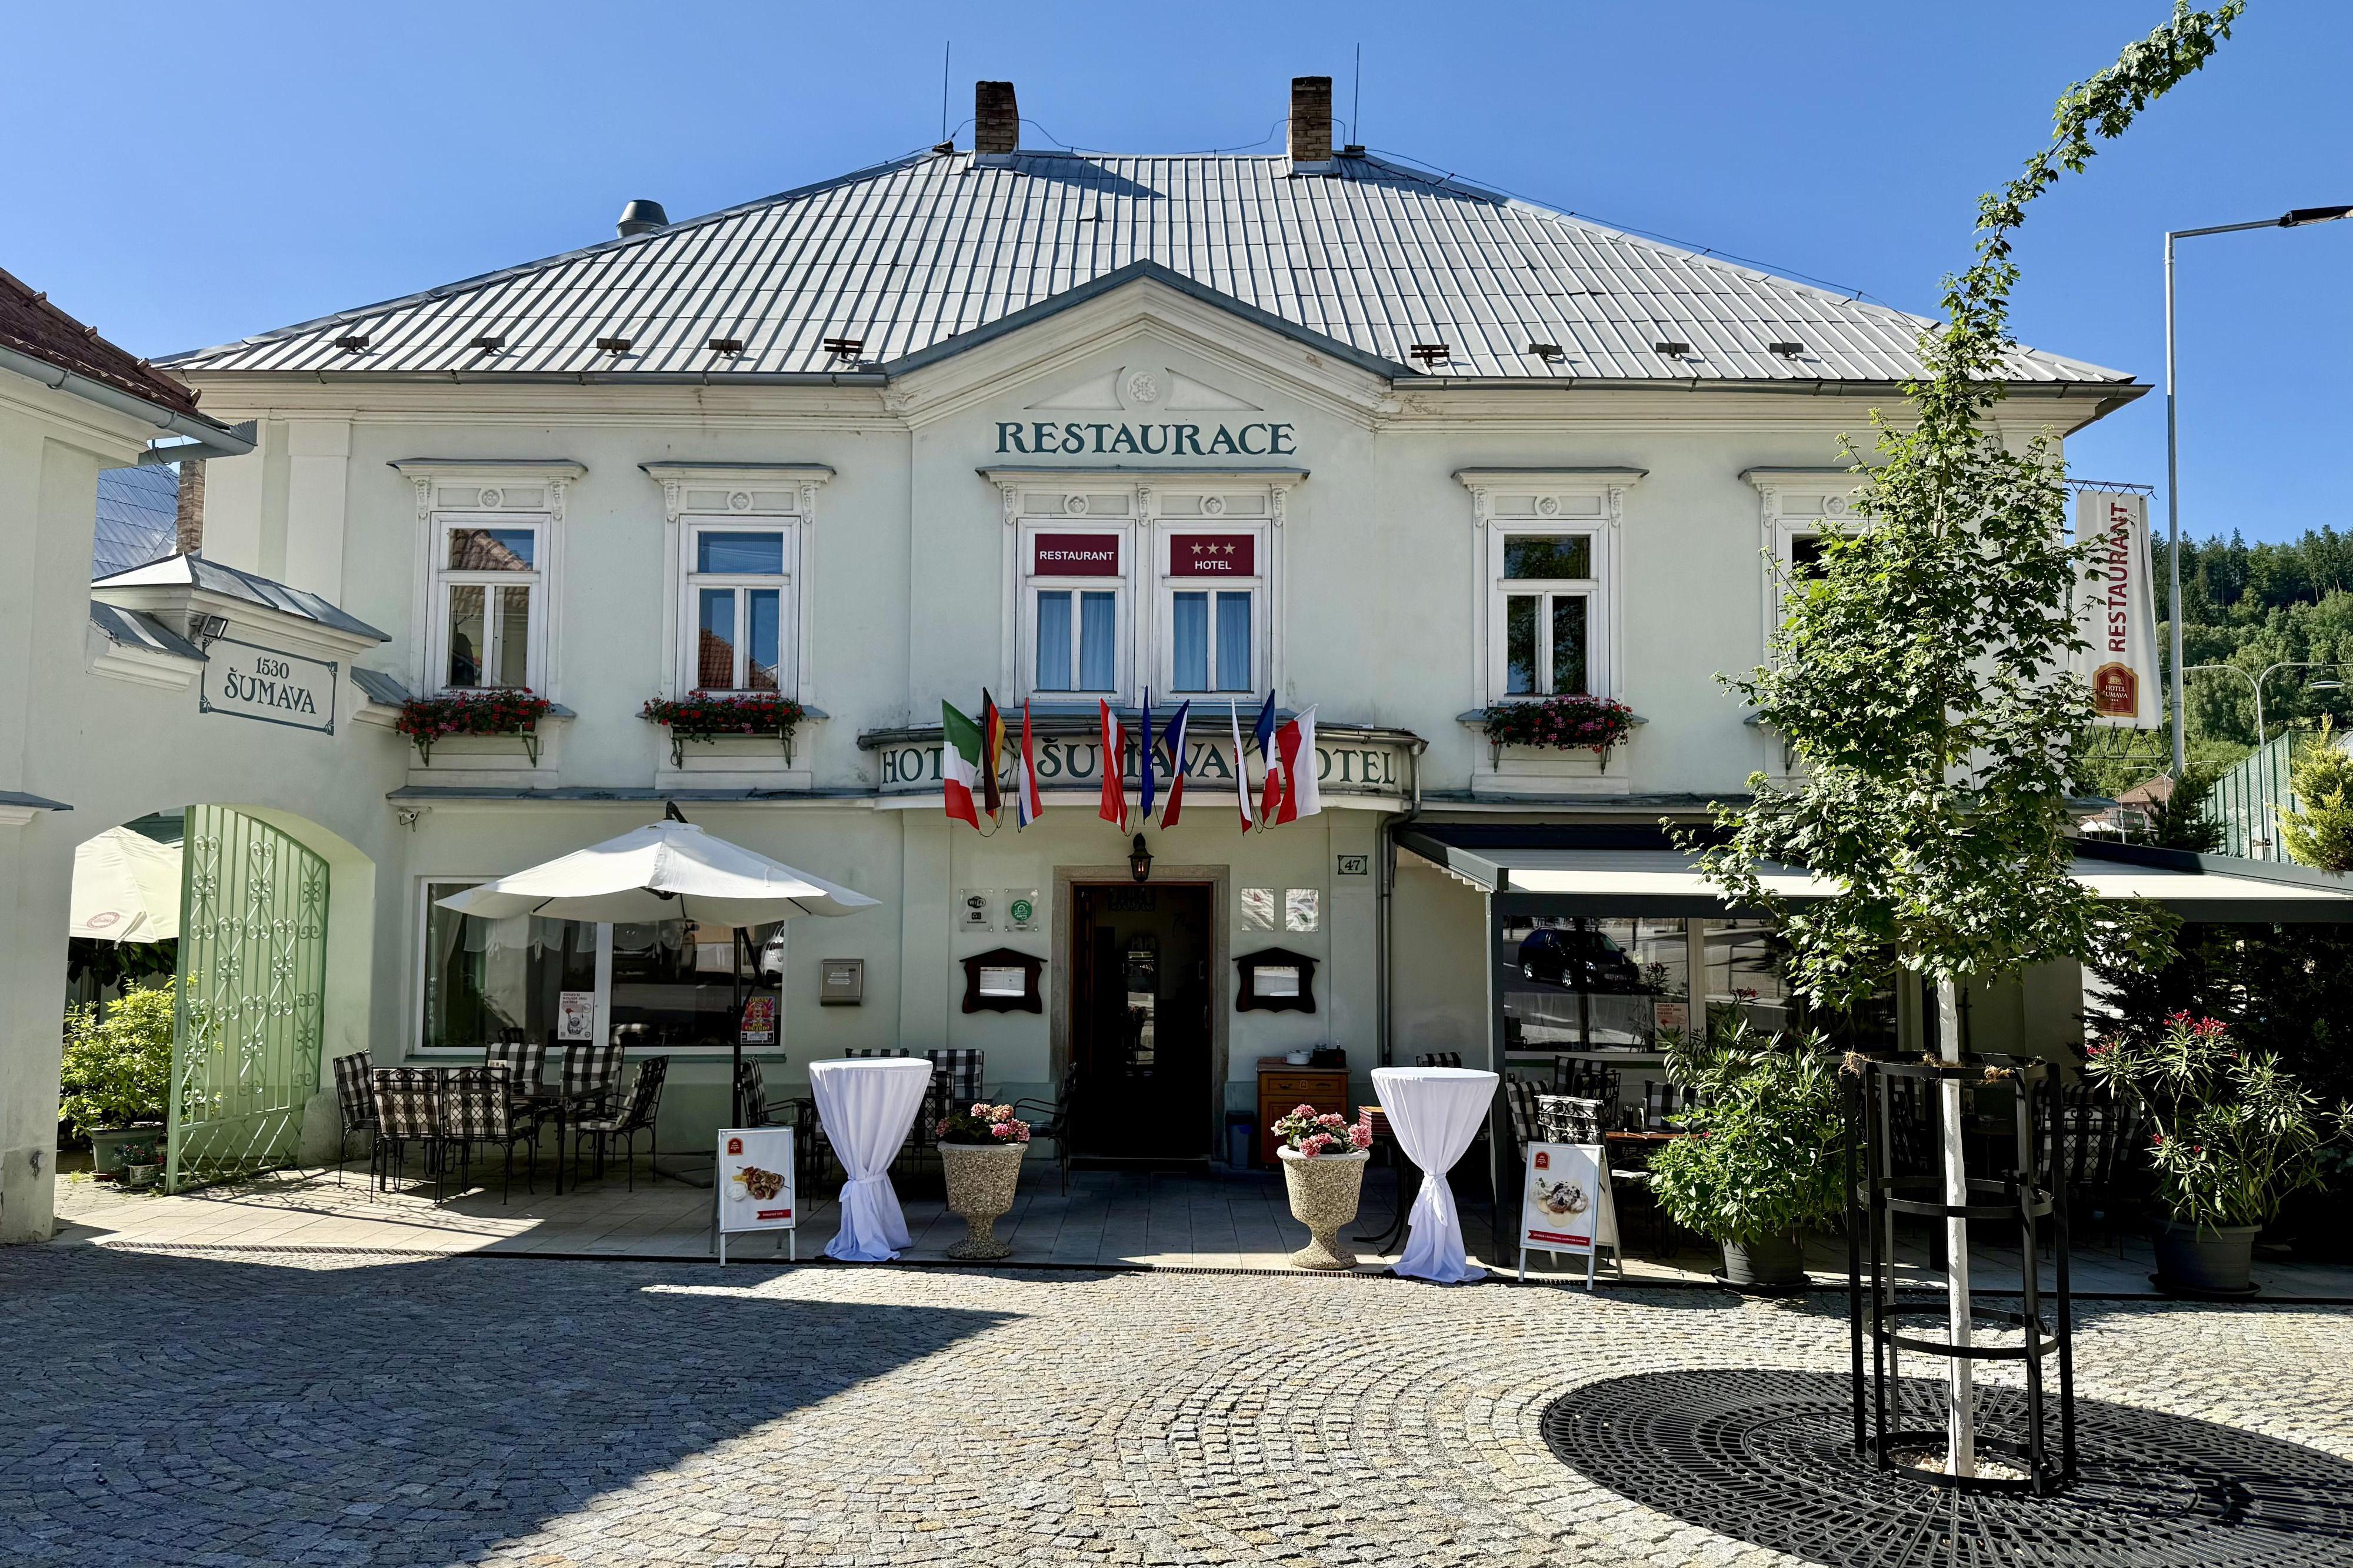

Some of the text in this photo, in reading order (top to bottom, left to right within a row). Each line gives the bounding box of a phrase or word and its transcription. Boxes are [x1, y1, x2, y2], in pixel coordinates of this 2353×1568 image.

[995, 422, 1297, 456] RESTAURACE
[1039, 551, 1114, 561] RESTAURANT
[1195, 561, 1232, 570] HOTEL
[2108, 502, 2128, 652] RESTAURANT
[256, 656, 289, 679] 1530
[224, 666, 316, 714] ŠUMAVA
[2102, 690, 2128, 699] UMAVA
[1345, 859, 1361, 870] 47
